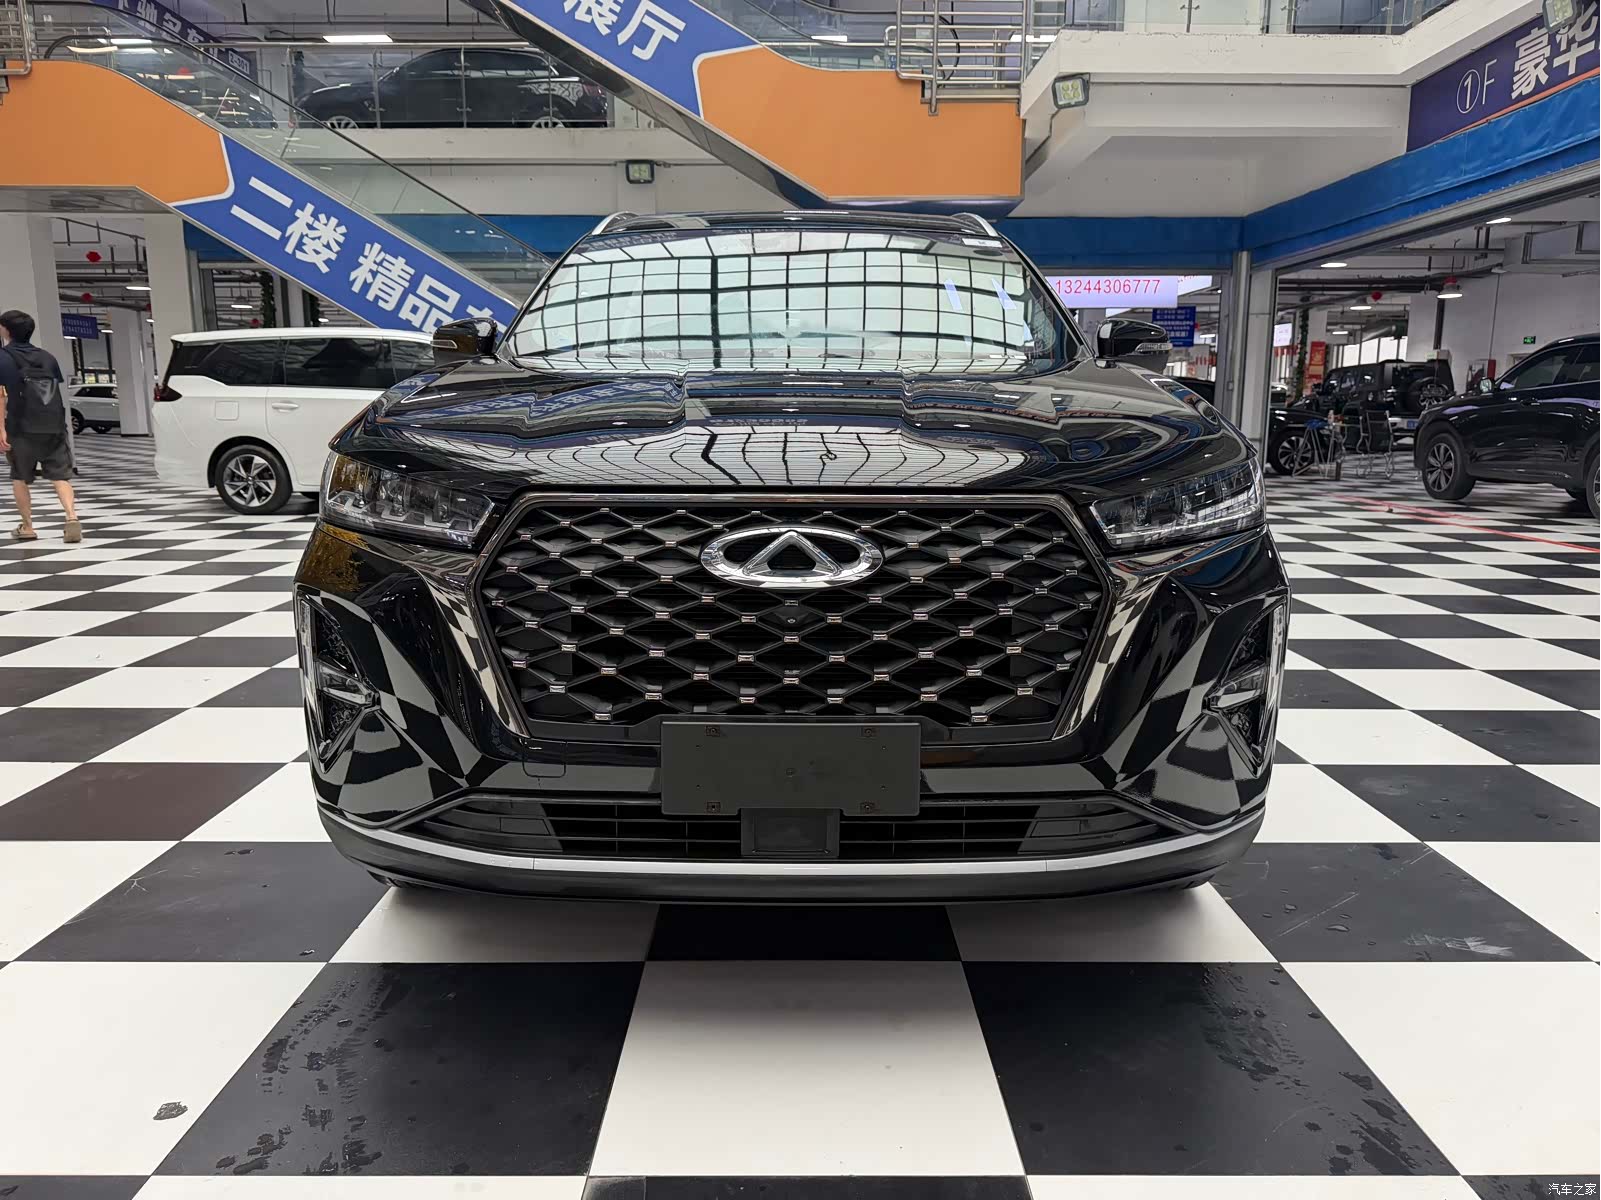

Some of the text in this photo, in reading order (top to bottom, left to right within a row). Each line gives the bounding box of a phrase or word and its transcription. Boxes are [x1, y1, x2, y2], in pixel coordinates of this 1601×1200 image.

[229, 52, 250, 73] 2-301
[230, 176, 348, 274] 二楼
[1055, 279, 1161, 295] 13244306777
